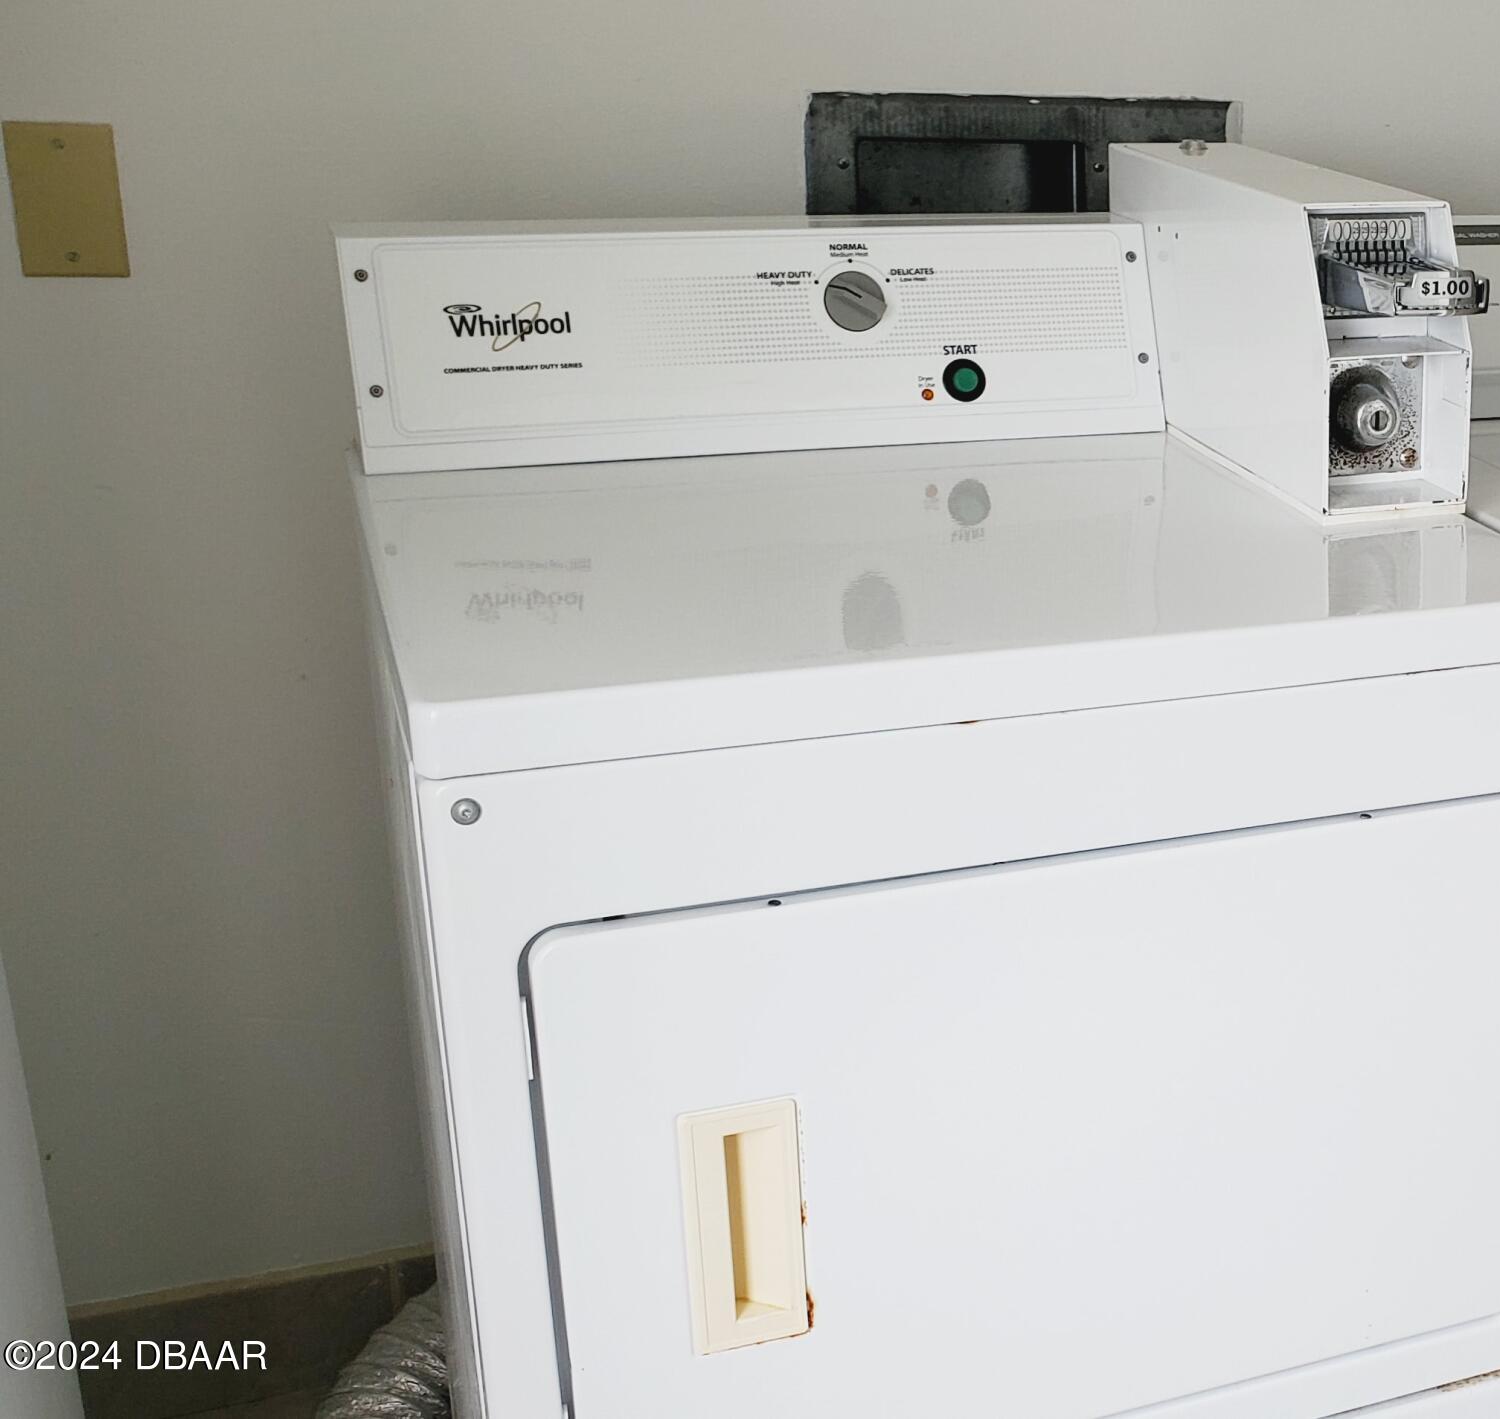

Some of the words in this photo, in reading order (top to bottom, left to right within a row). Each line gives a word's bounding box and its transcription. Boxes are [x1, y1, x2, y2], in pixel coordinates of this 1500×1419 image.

[829, 243, 868, 251] NORMAL
[756, 271, 786, 279] HEAVY
[787, 271, 812, 279] DUTY
[890, 267, 935, 276] DELICATES
[1421, 279, 1470, 297] $1.00
[448, 311, 571, 342] Whirlpool
[943, 344, 978, 356] START
[443, 366, 491, 374] COMMERCIAL
[491, 365, 515, 373] DRYER
[515, 364, 538, 372] HEAVY
[540, 363, 559, 371] DUTY
